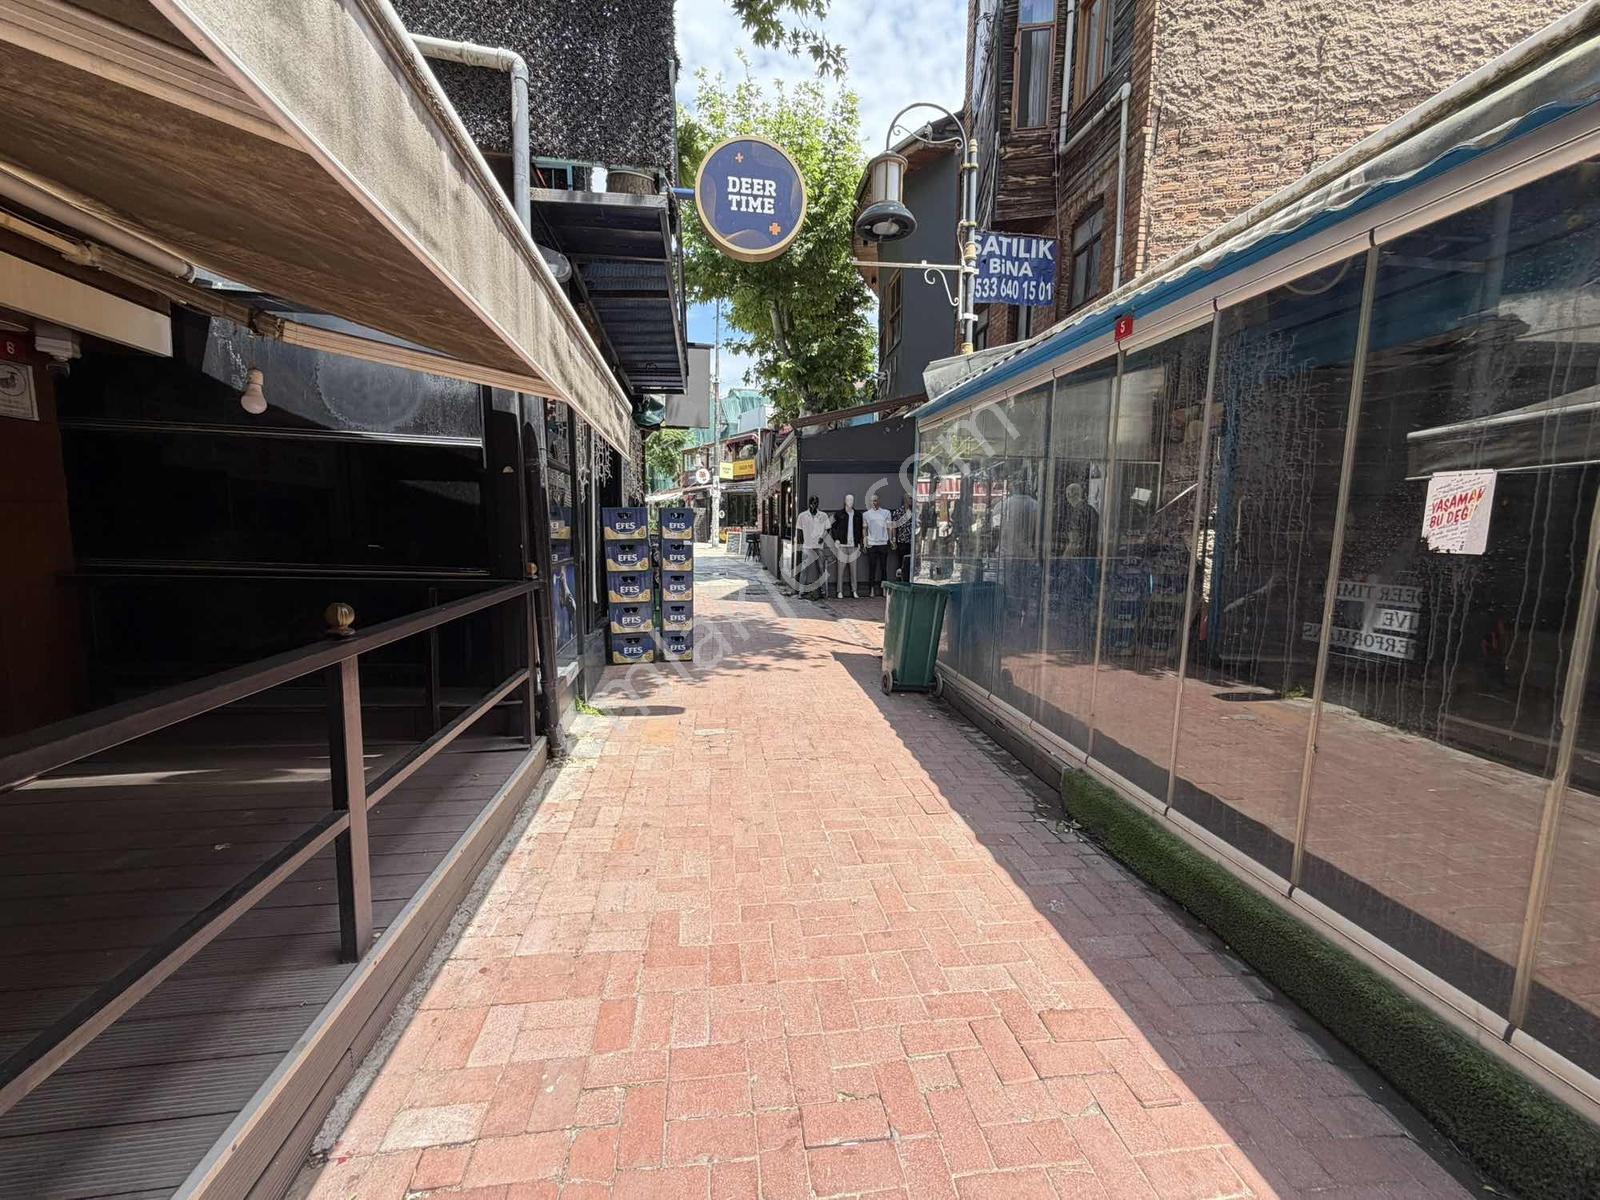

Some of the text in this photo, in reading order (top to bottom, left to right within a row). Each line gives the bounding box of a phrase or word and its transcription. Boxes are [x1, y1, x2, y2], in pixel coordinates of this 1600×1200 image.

[727, 176, 776, 196] DEER
[728, 194, 775, 215] TIME
[974, 234, 1055, 260] SATILIK
[1000, 278, 1019, 300] 640
[1022, 281, 1036, 300] 15
[1038, 281, 1051, 301] 01
[1120, 320, 1125, 333] 5
[615, 522, 636, 530] EFES
[1429, 513, 1444, 529] BU
[618, 554, 638, 562] EFES
[620, 585, 640, 594] EFES
[622, 616, 641, 624] EFES
[623, 646, 643, 655] EFES
